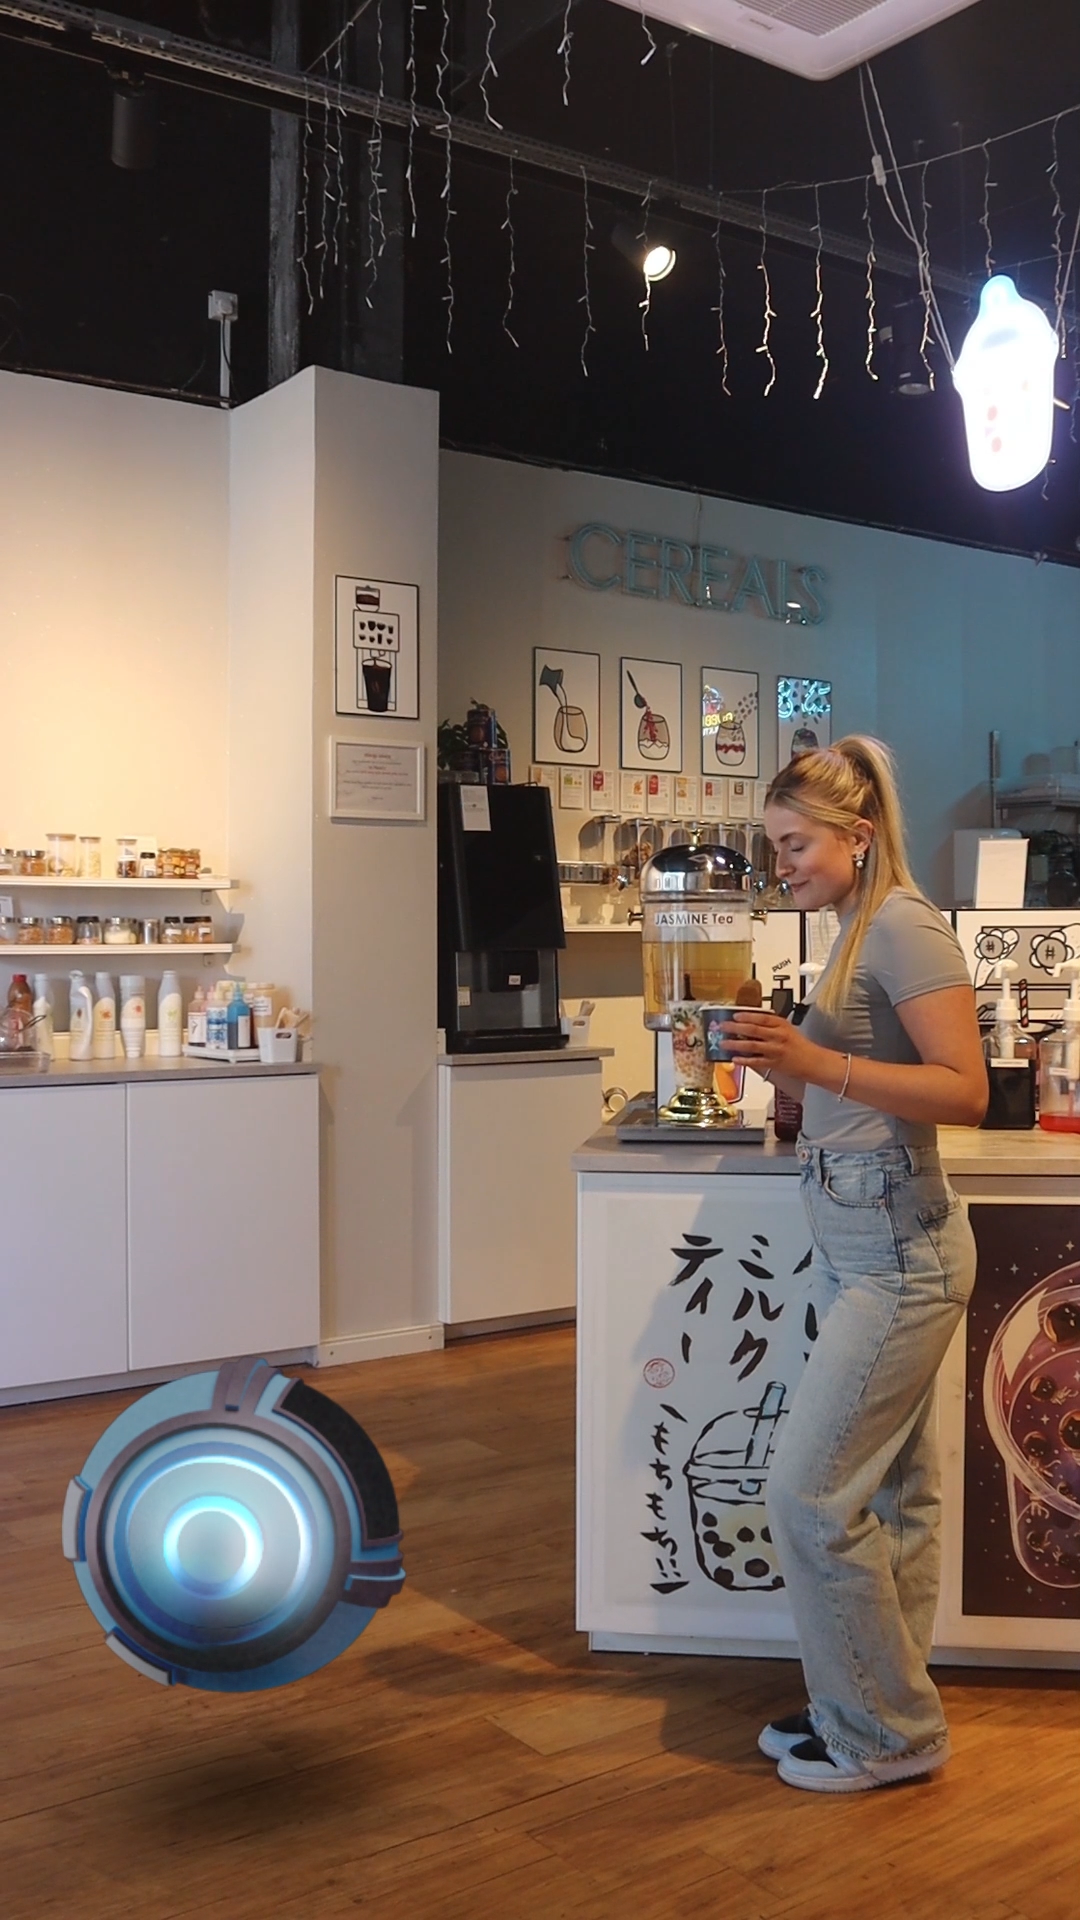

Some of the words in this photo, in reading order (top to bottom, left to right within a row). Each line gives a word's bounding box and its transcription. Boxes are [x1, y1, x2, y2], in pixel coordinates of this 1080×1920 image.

[569, 522, 827, 625] CEREALS
[655, 912, 708, 926] JASMINE
[712, 913, 733, 925] Tea
[771, 958, 792, 973] PUSH
[729, 1234, 785, 1382] ミルク
